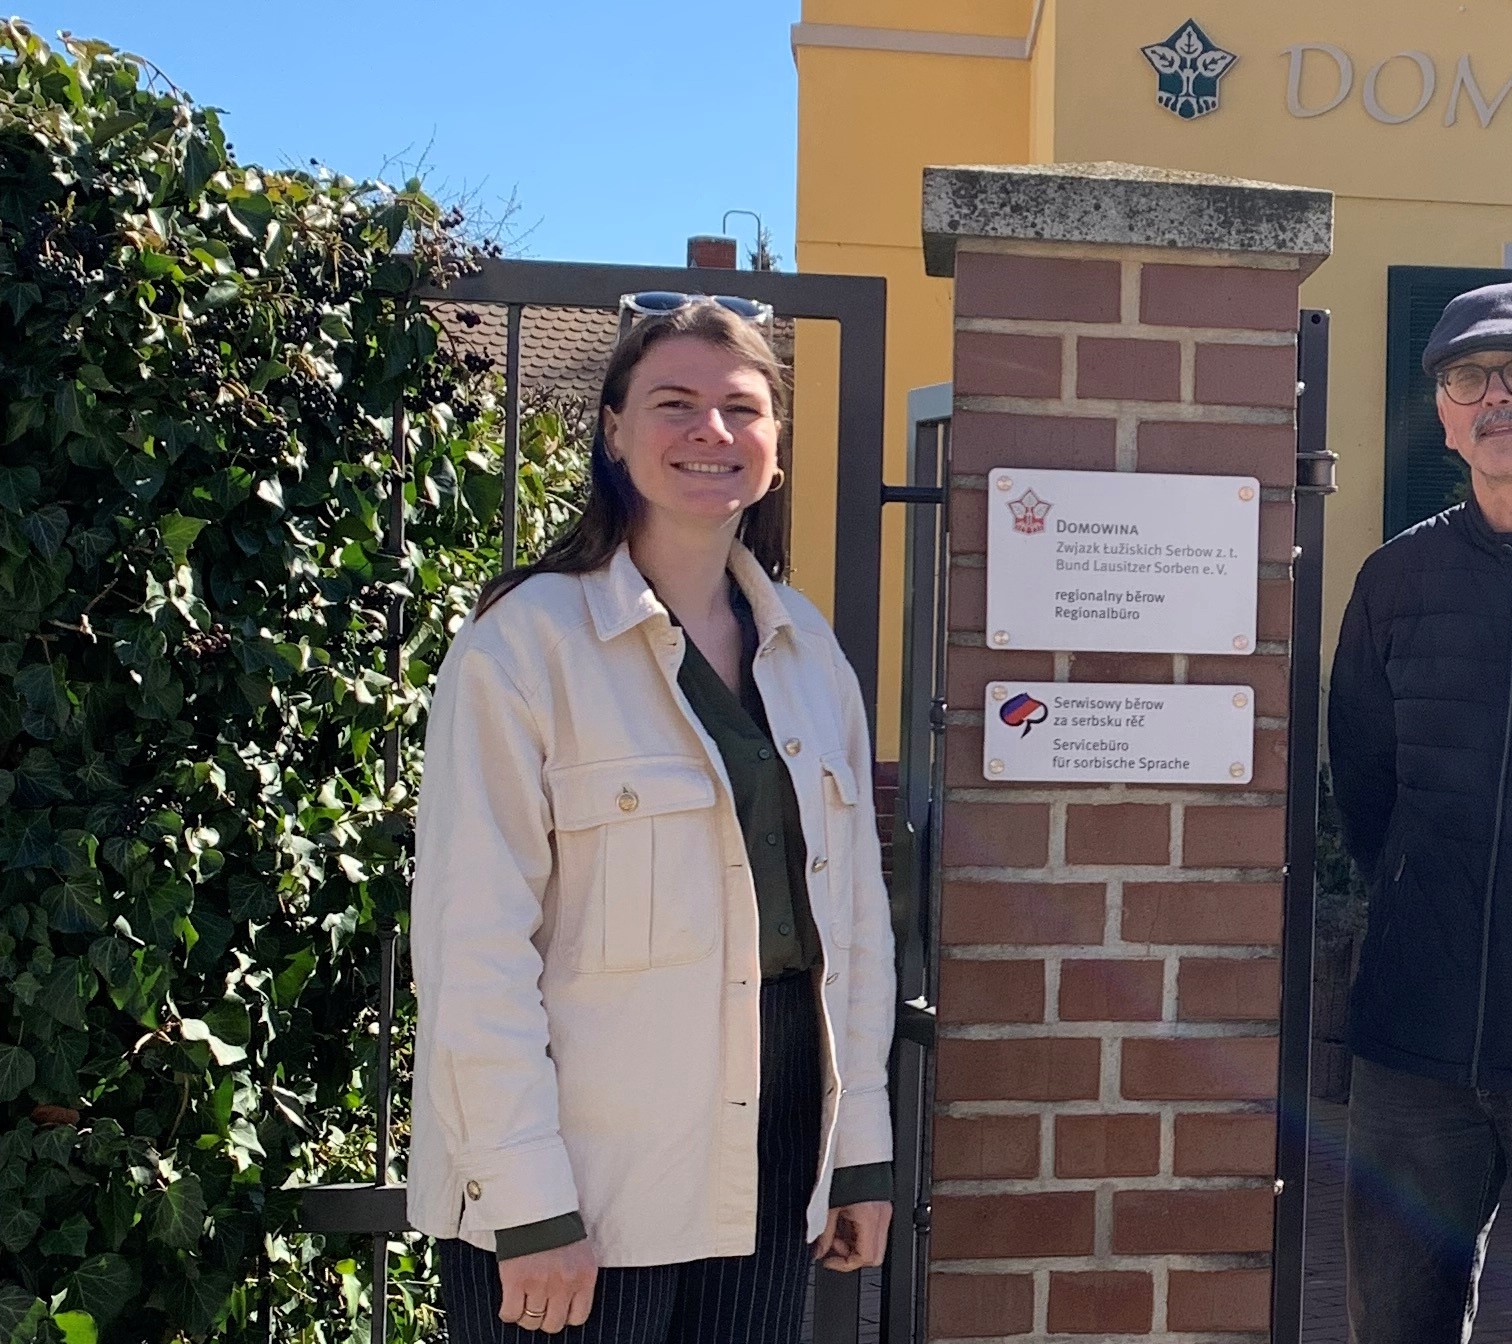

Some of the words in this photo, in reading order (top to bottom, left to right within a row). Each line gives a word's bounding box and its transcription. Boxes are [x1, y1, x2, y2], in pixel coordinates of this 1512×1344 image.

[1056, 541, 1100, 556] Zwjazk
[1165, 544, 1213, 558] Serbow
[1056, 558, 1090, 571] Bund
[1093, 560, 1151, 573] Lausitzer
[1154, 561, 1199, 575] Sorben
[1202, 566, 1214, 575] e.
[1216, 563, 1228, 576] V.
[1055, 589, 1122, 604] regionalny
[1126, 590, 1165, 603] běrow
[1055, 606, 1140, 621] Regionalbüro
[1054, 696, 1122, 712] Serwisowy
[1125, 697, 1164, 710] běrow
[1053, 716, 1067, 726] za
[1071, 715, 1122, 727] serbsku
[1126, 715, 1145, 727] rěč
[1053, 738, 1129, 752] Servicebüro
[1052, 755, 1070, 769] für
[1073, 756, 1136, 770] sorbische
[1139, 757, 1190, 772] Sprache
